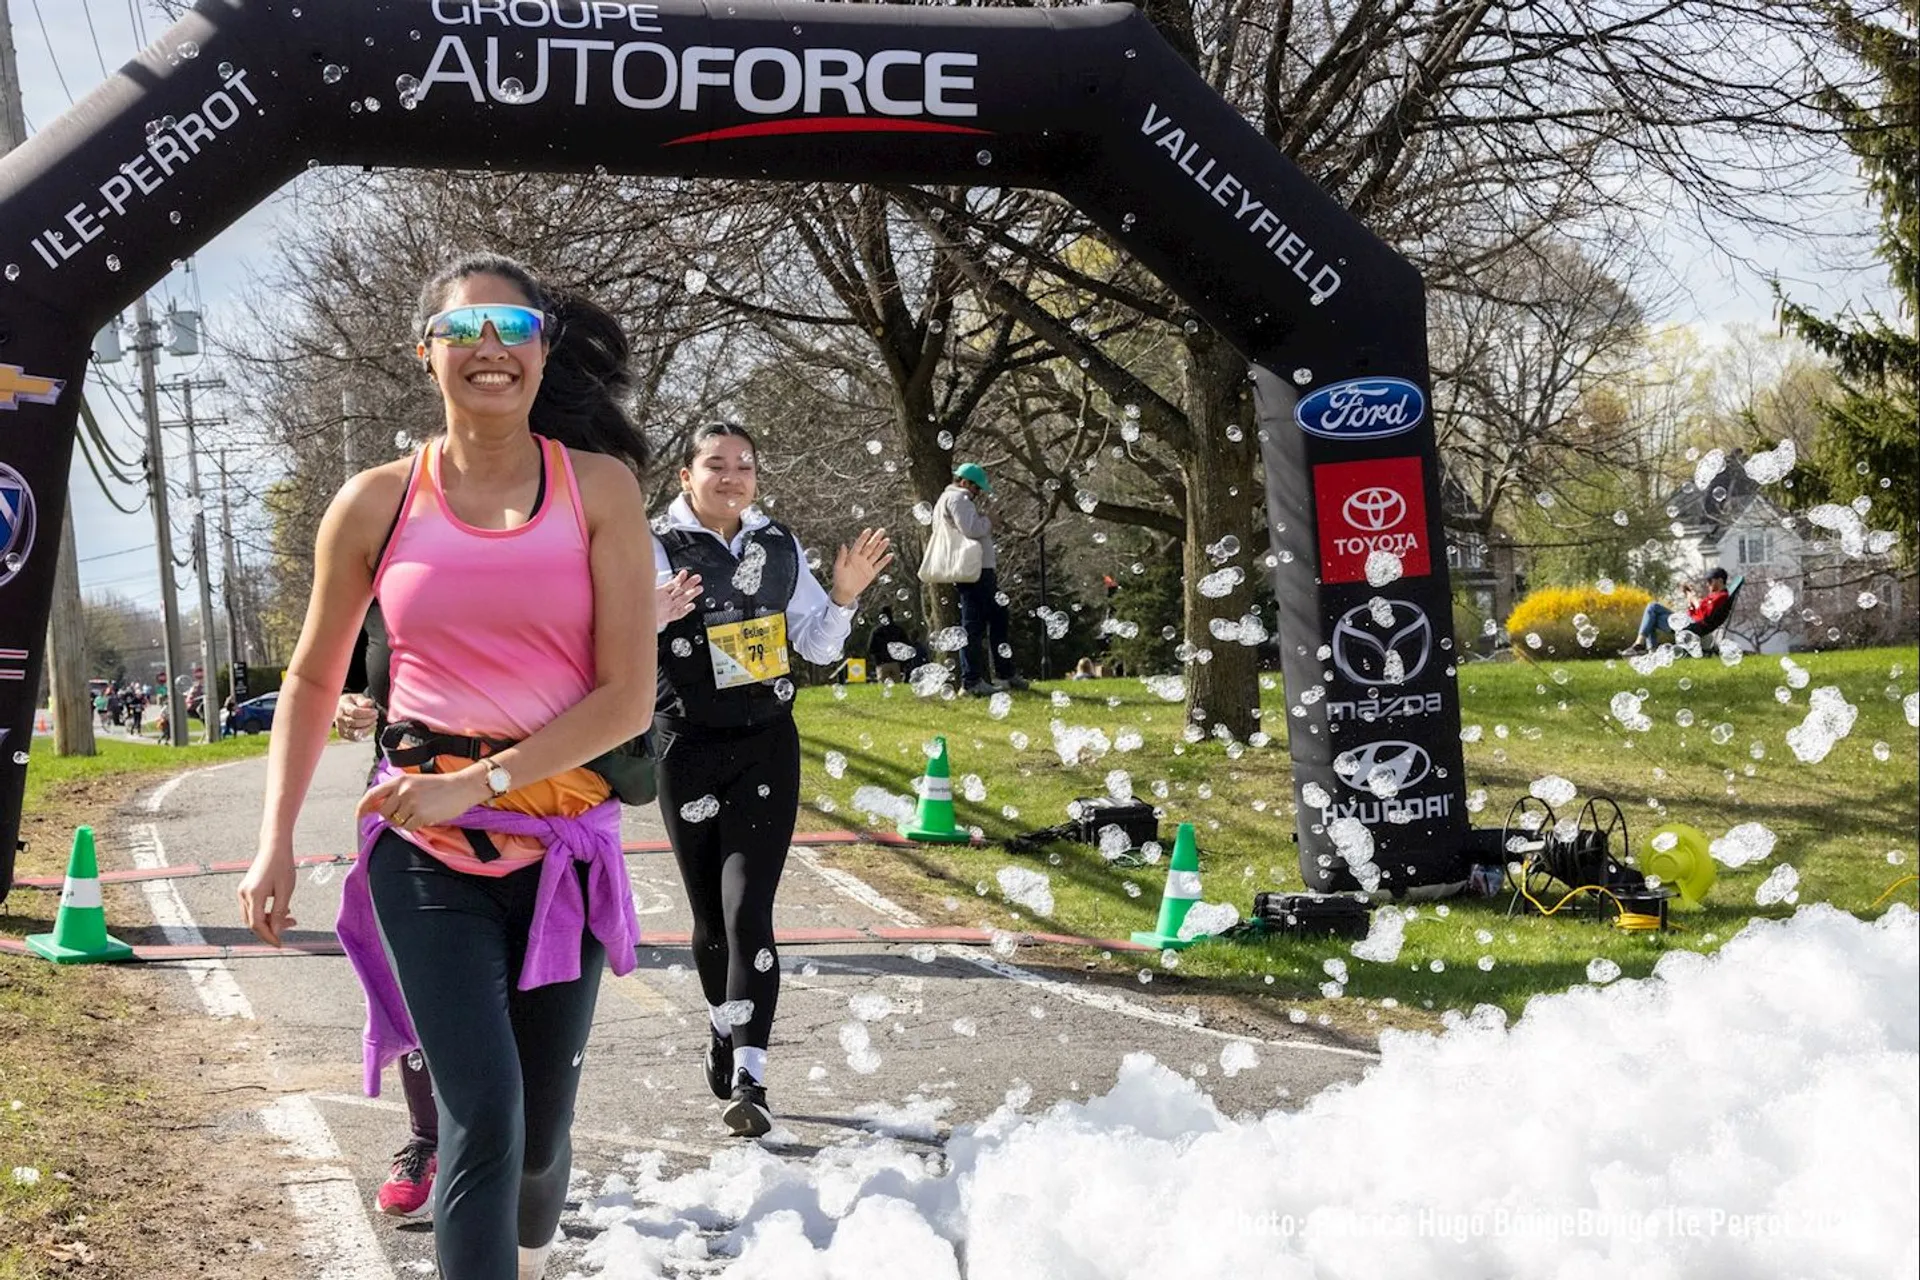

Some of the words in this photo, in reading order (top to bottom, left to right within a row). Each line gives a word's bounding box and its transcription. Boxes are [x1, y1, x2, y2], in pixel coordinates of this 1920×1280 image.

[432, 0, 663, 33] GROUPE
[416, 35, 978, 117] AUTOFORCE
[31, 68, 259, 271] ILE-PERROT
[1140, 102, 1342, 300] VALLEYFIELD
[1320, 387, 1409, 431] Ford
[1334, 532, 1419, 556] TOYOTA
[748, 643, 764, 663] 79
[1321, 794, 1450, 826] HYUNDAI
